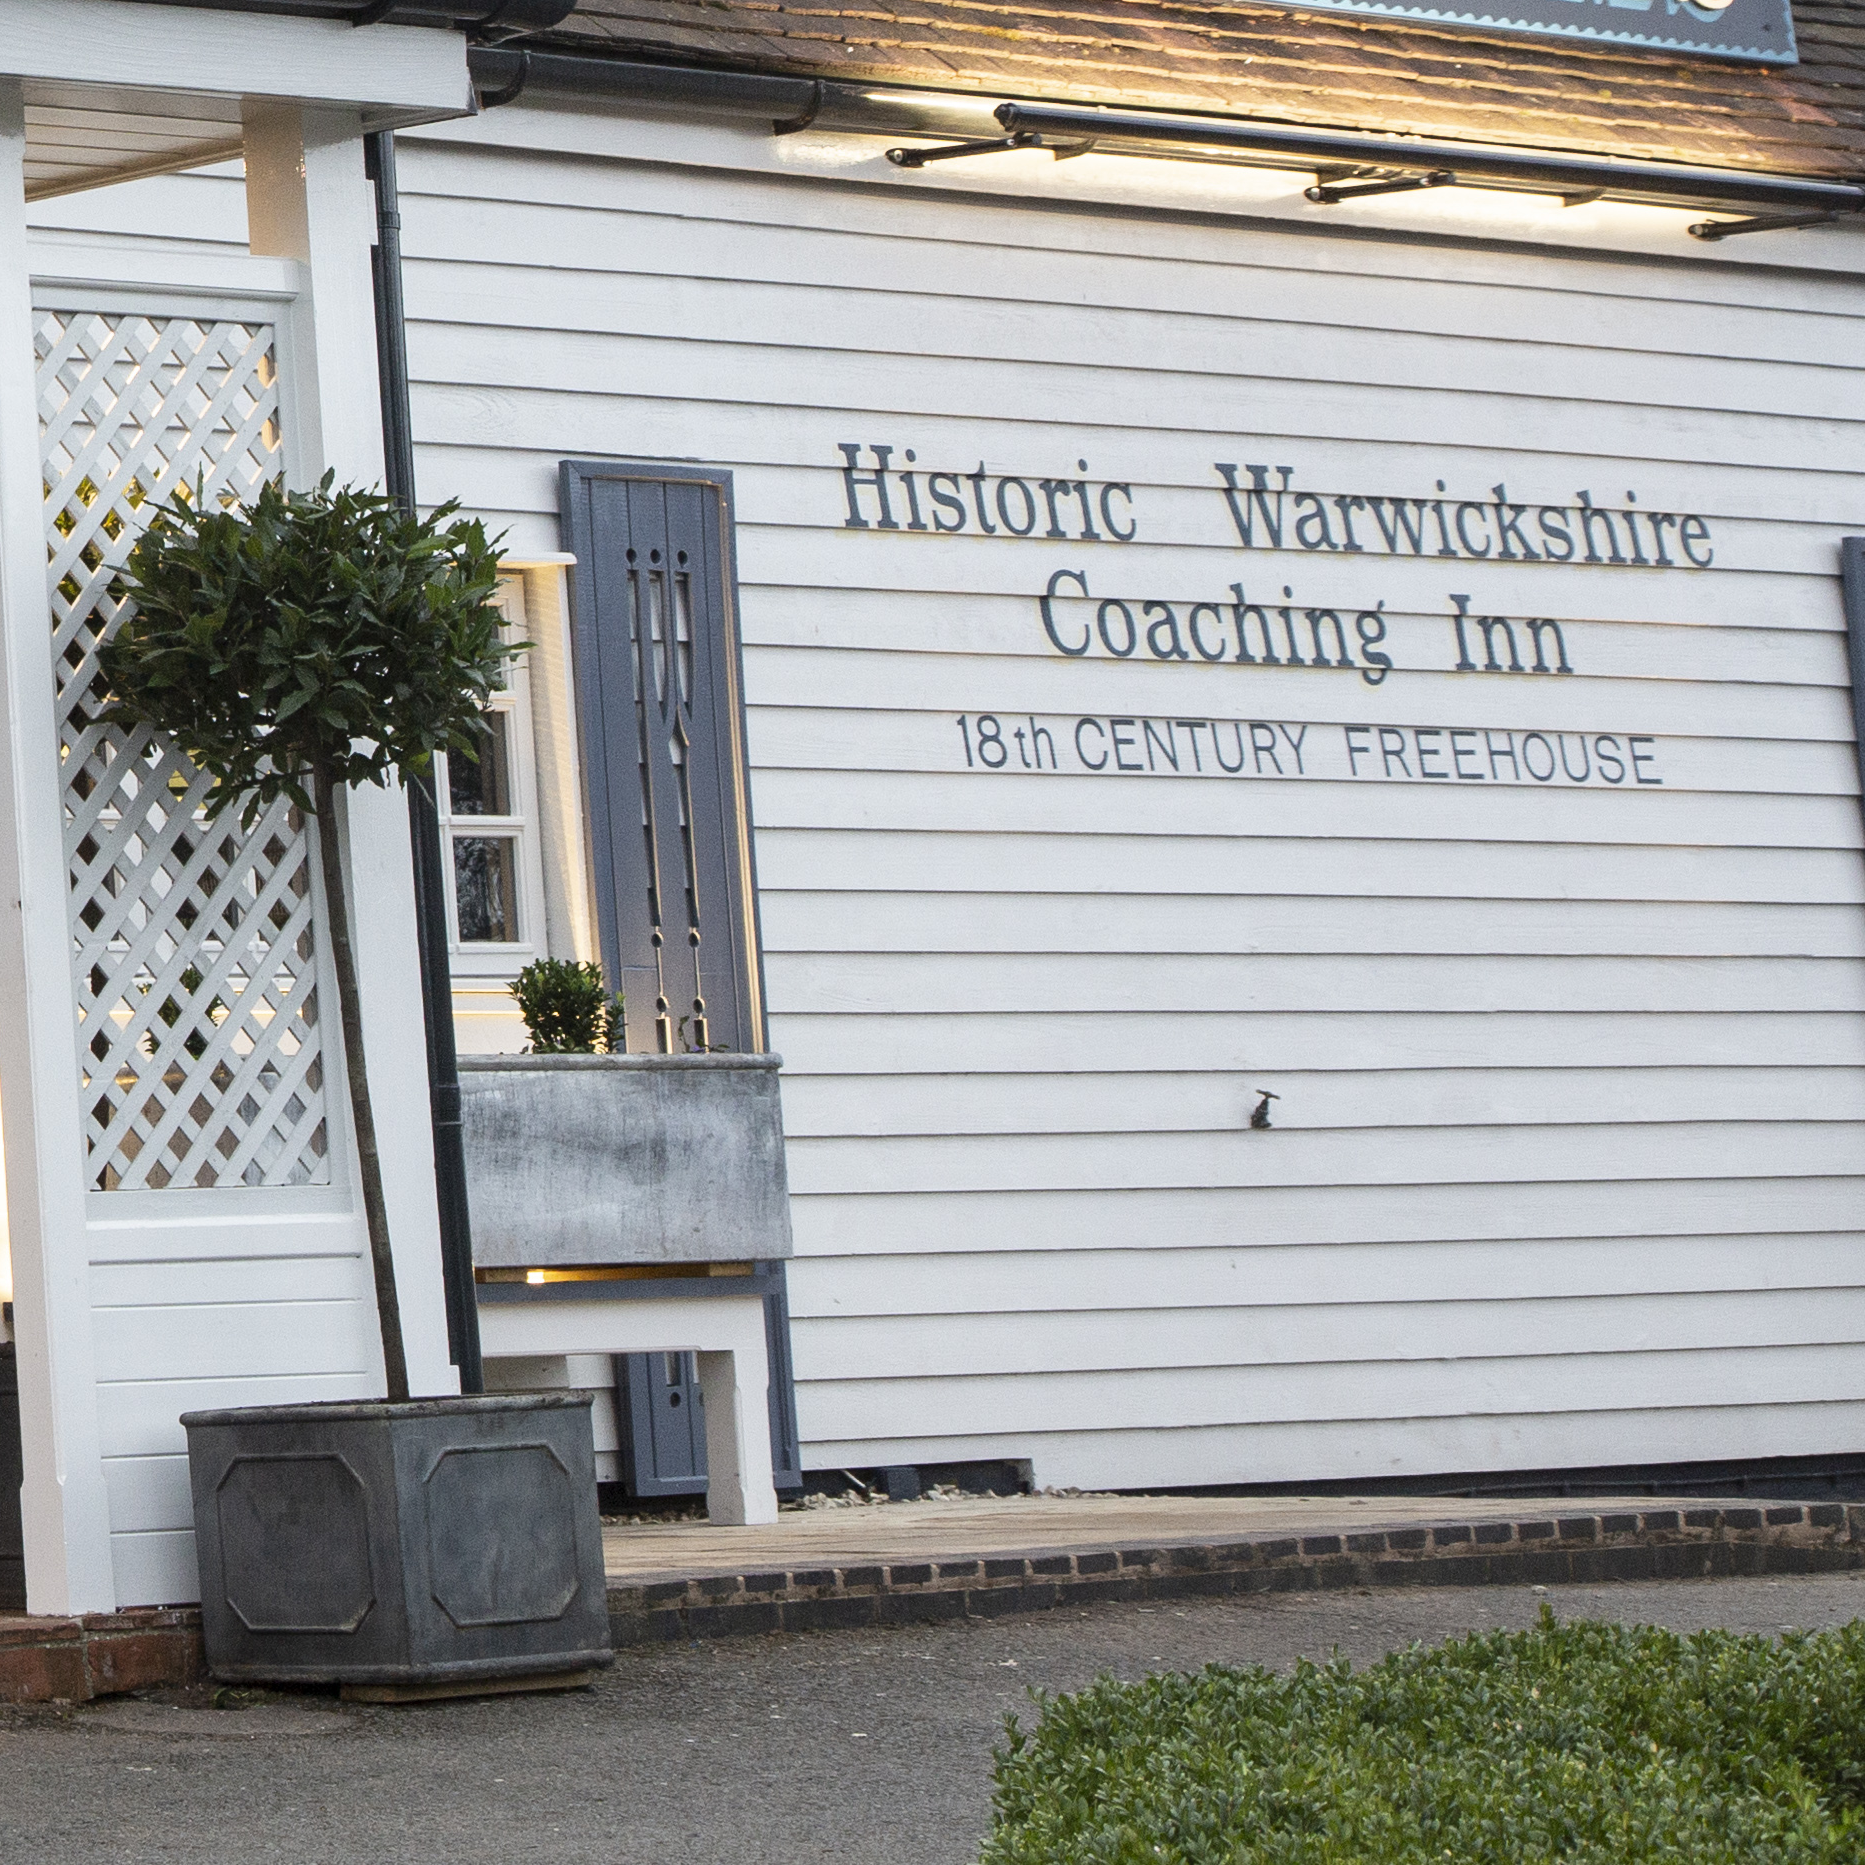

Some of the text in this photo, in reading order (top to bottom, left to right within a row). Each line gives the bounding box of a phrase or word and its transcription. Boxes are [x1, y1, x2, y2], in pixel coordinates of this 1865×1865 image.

[837, 442, 1716, 569] Historic Warwickshire
[1039, 569, 1575, 686] Coaching Inn
[955, 713, 1664, 786] 18th CENTURY FREEHOUSE
